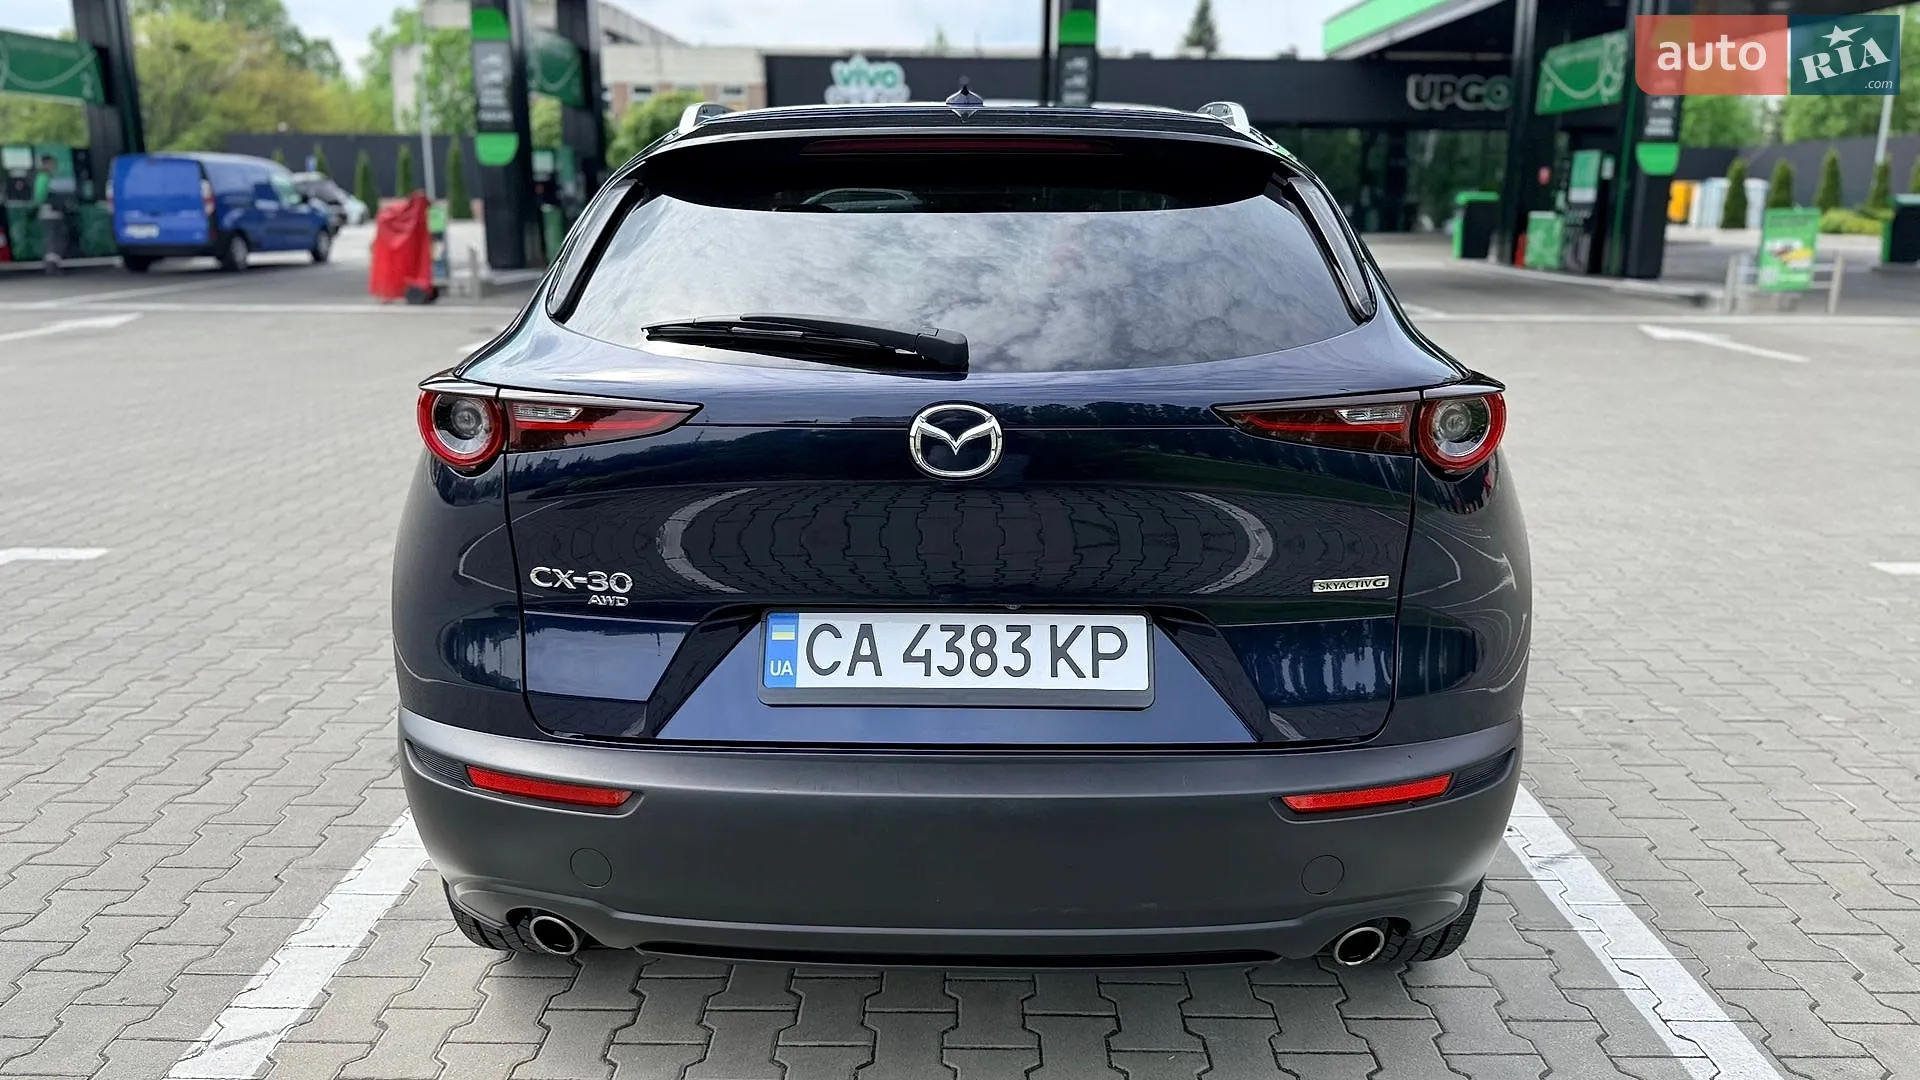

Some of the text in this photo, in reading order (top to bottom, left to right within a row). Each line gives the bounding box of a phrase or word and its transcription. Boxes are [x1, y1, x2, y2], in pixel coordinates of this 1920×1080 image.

[529, 566, 633, 594] CX-30
[587, 594, 629, 607] AWD
[805, 623, 1129, 679] CA 4383 KP
[769, 659, 794, 677] UA
